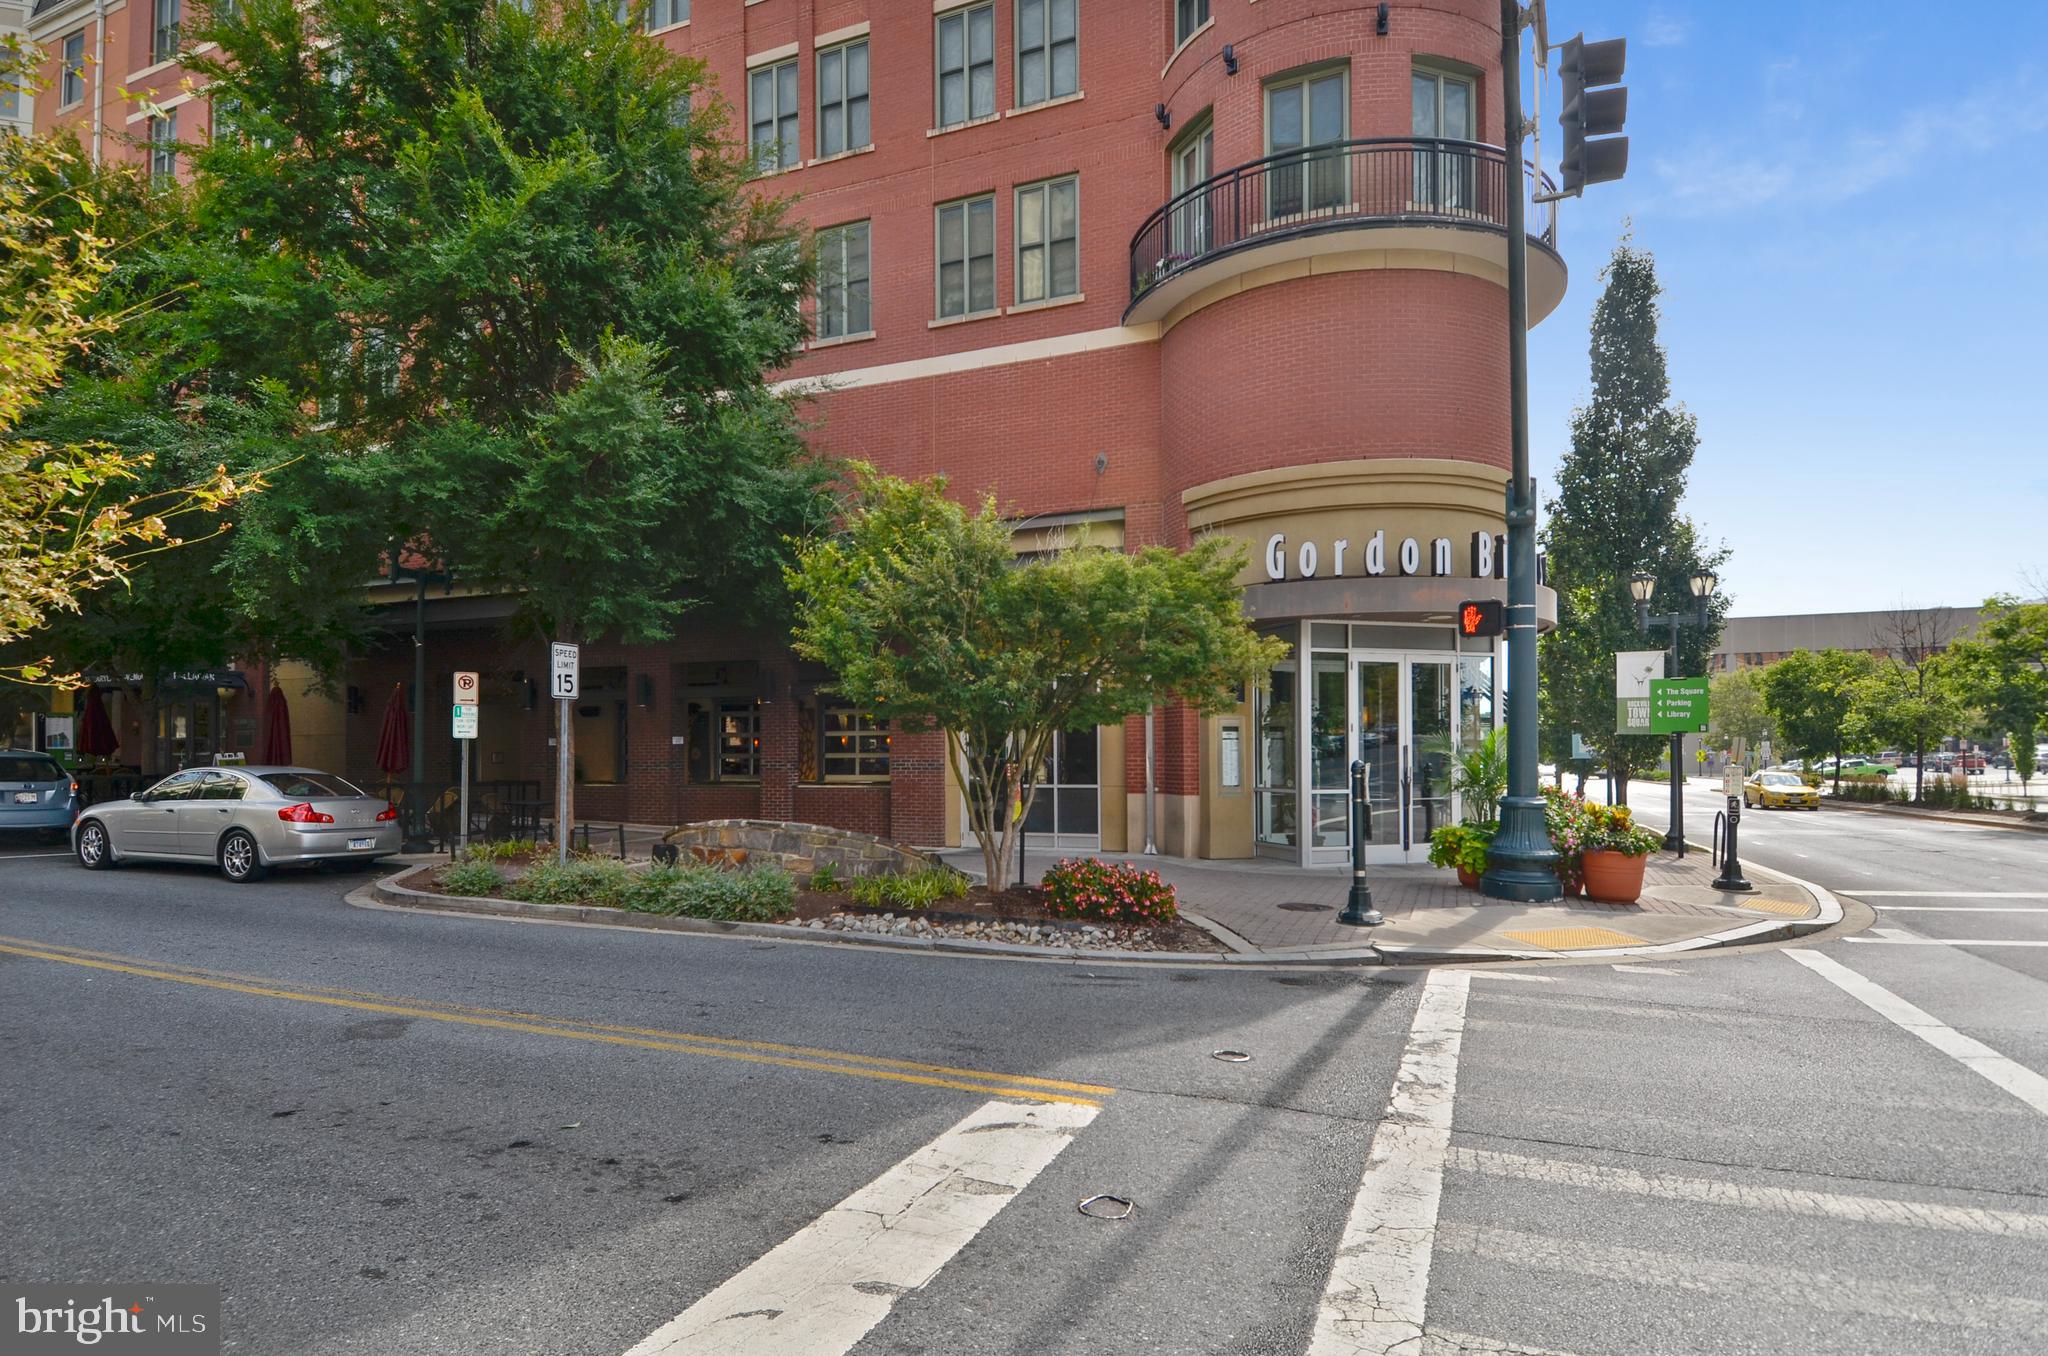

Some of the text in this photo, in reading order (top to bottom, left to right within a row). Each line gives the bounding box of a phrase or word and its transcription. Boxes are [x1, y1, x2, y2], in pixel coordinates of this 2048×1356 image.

[1265, 529, 1452, 580] Gordon
[554, 648, 577, 659] SPEED
[556, 660, 575, 670] LIMIT
[557, 673, 574, 693] 15
[1680, 687, 1704, 696] Square
[1666, 699, 1692, 707] Parking
[1666, 711, 1691, 719] Library
